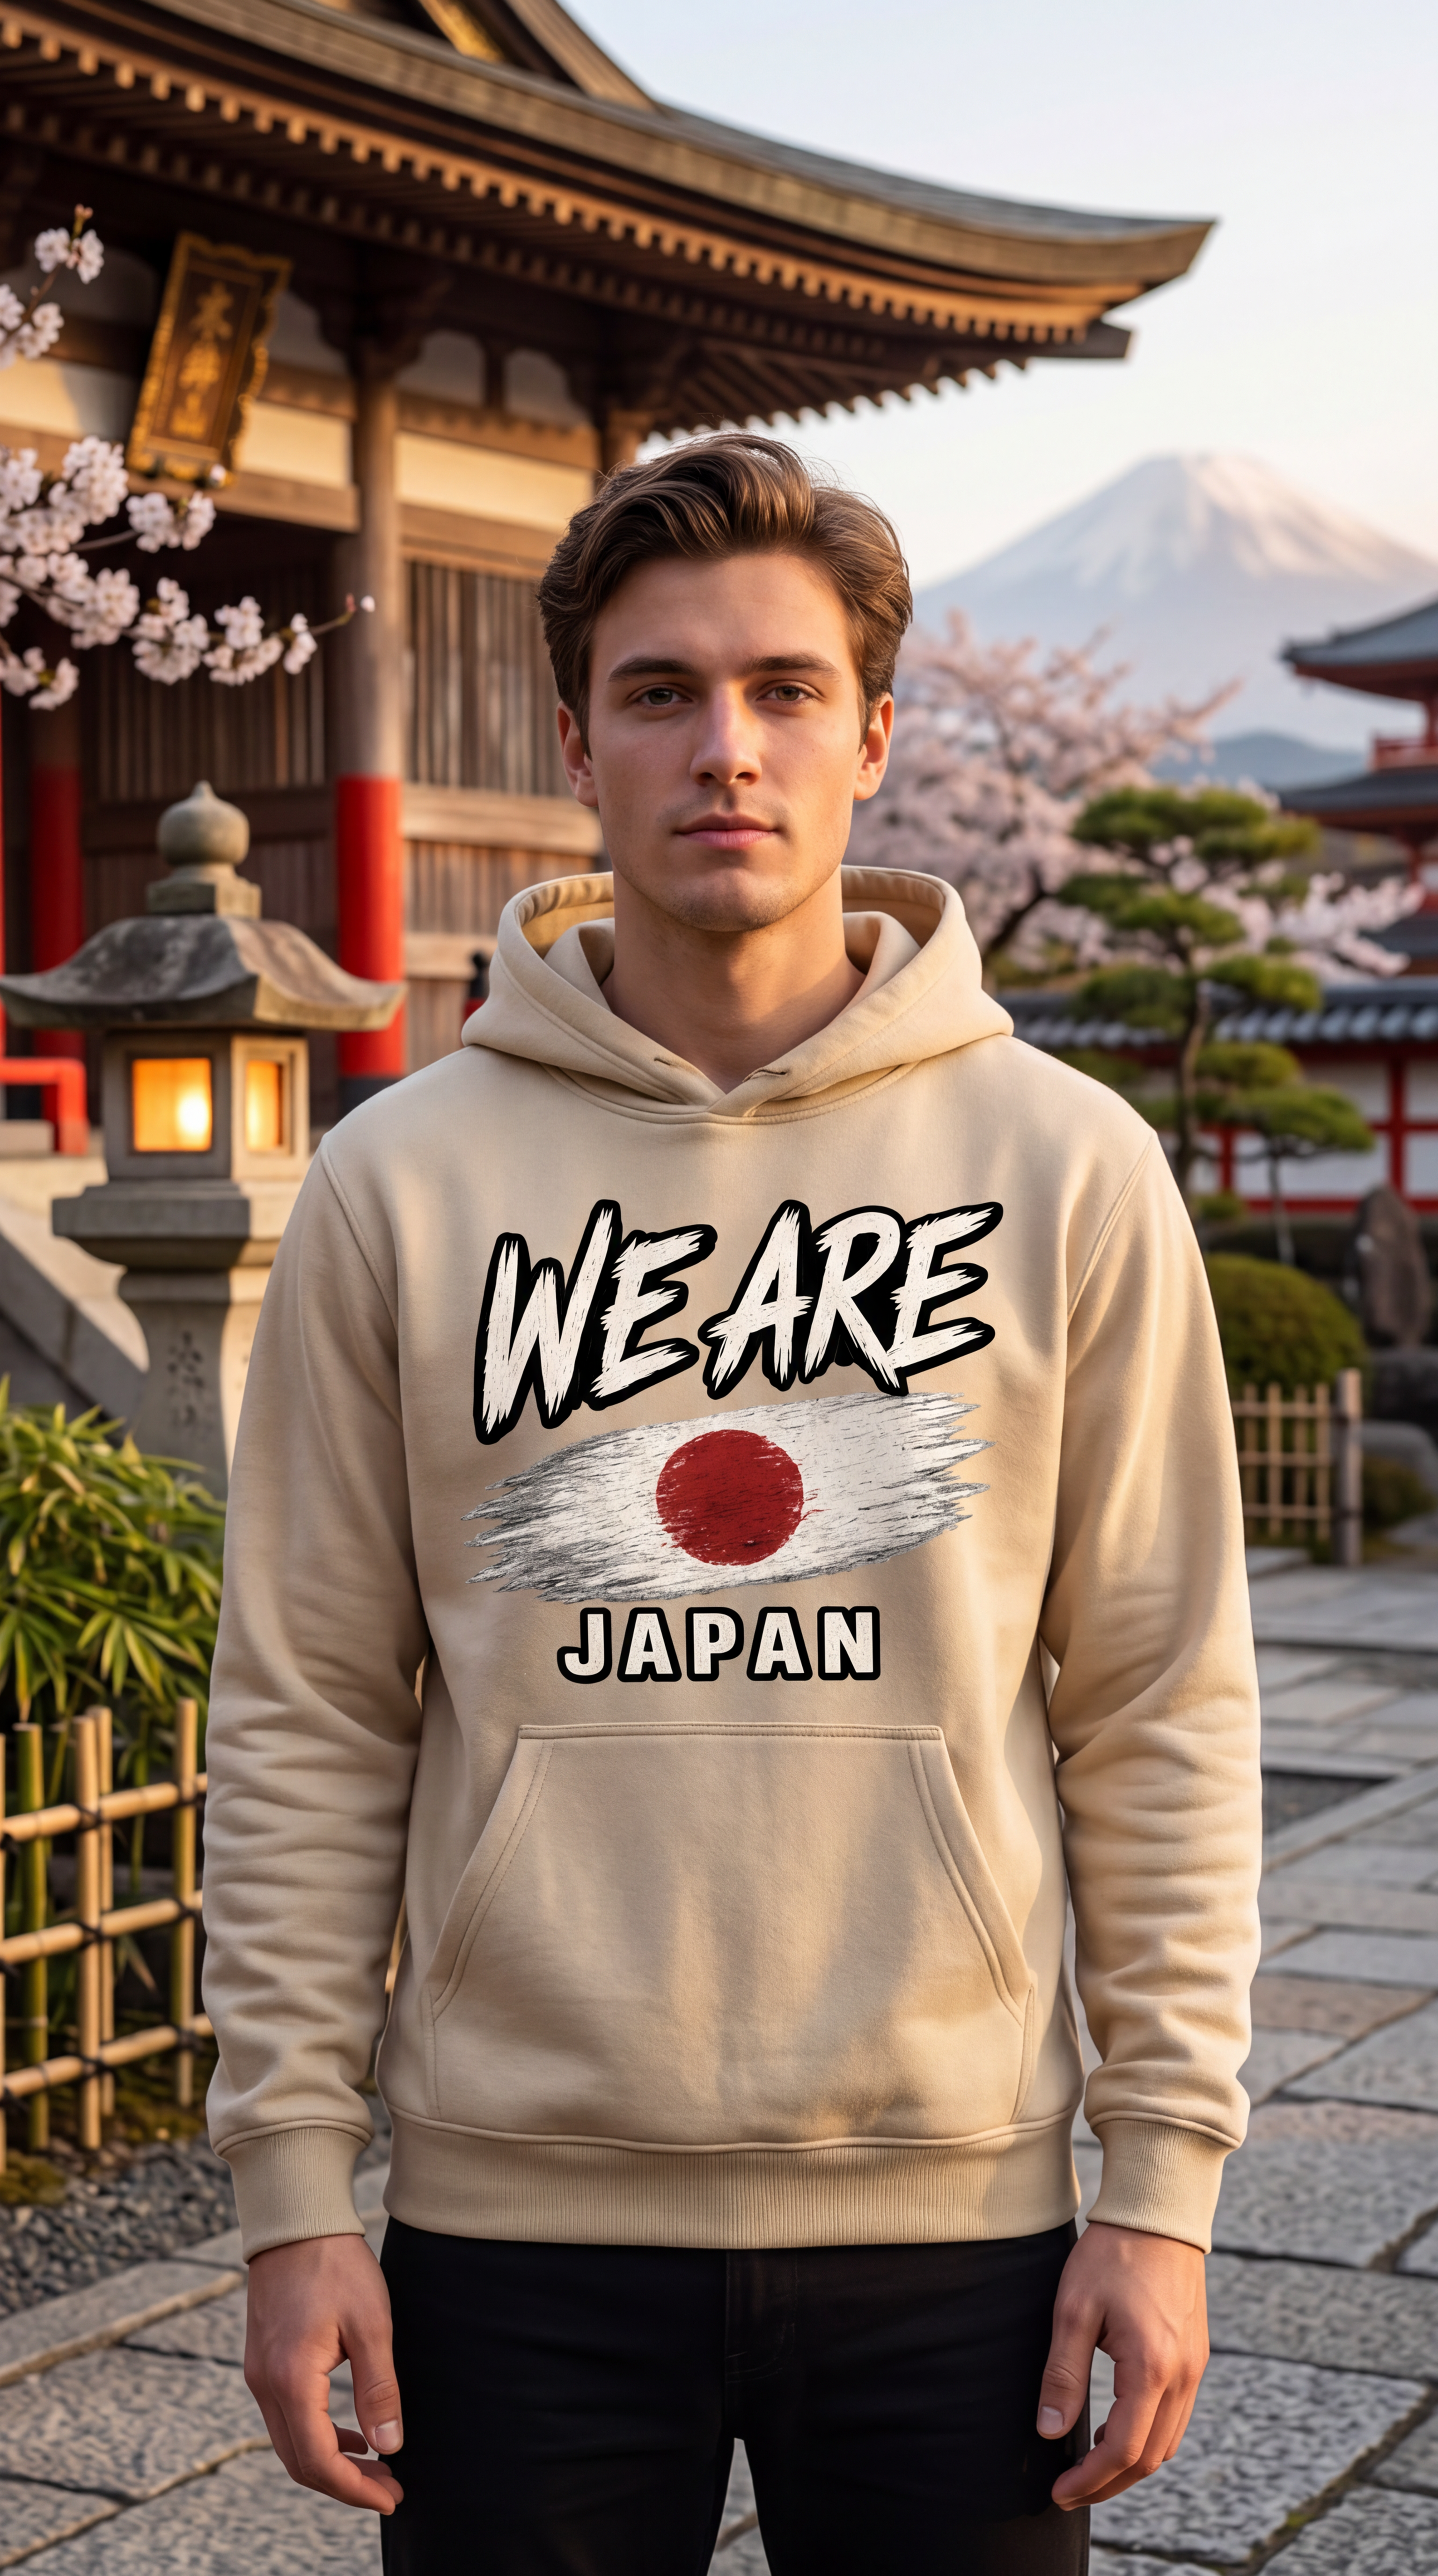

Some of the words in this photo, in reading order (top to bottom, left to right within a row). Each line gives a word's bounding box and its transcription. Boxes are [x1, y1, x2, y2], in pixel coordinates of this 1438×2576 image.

[474, 1200, 717, 1444] WE
[698, 1200, 1003, 1398] ARE
[557, 1606, 880, 1684] JAPAN
